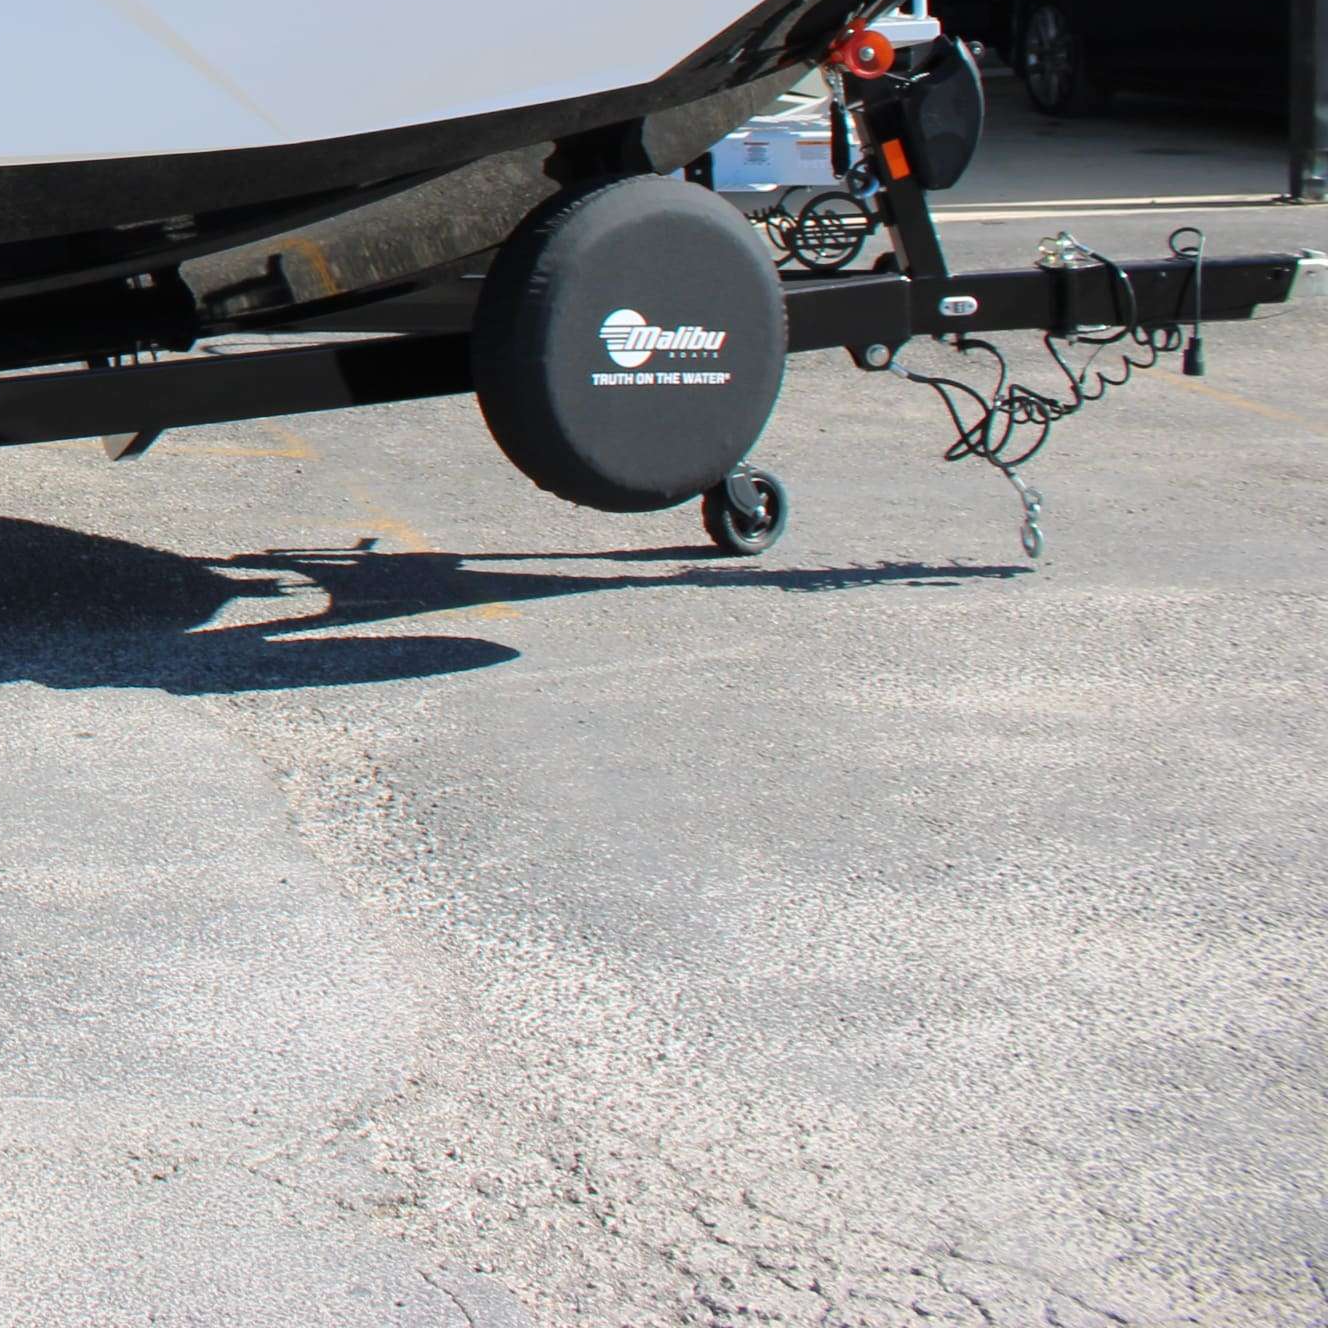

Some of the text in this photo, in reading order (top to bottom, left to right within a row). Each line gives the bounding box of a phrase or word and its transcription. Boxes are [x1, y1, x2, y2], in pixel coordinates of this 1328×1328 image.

[624, 326, 726, 350] Malibu
[592, 373, 633, 385] TRUTH
[635, 373, 654, 385] ON
[657, 373, 681, 385] THE
